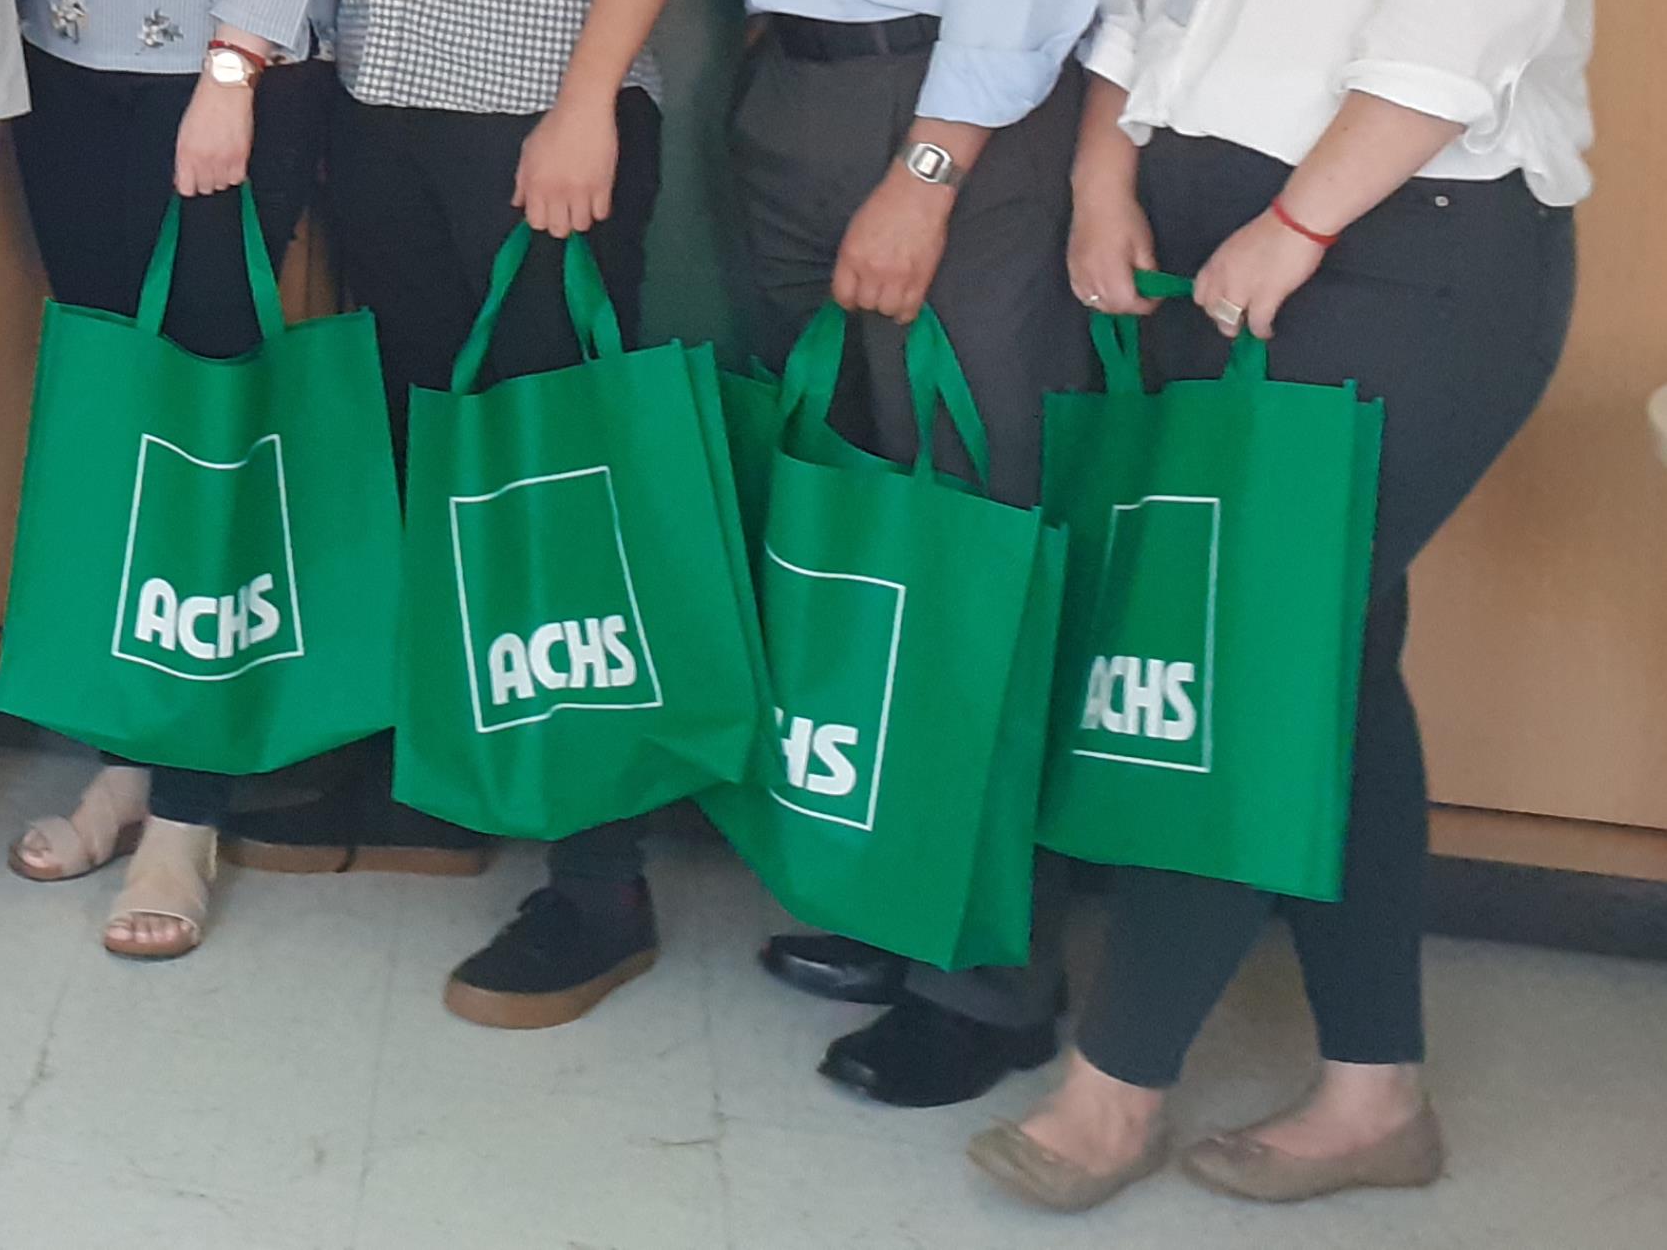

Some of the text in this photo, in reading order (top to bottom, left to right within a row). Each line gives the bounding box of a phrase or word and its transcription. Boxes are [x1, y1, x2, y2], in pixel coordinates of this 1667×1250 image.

[135, 573, 280, 660] ACHS
[488, 614, 637, 705] ACHS
[1080, 655, 1197, 741] ACHS
[774, 706, 859, 796] HS
